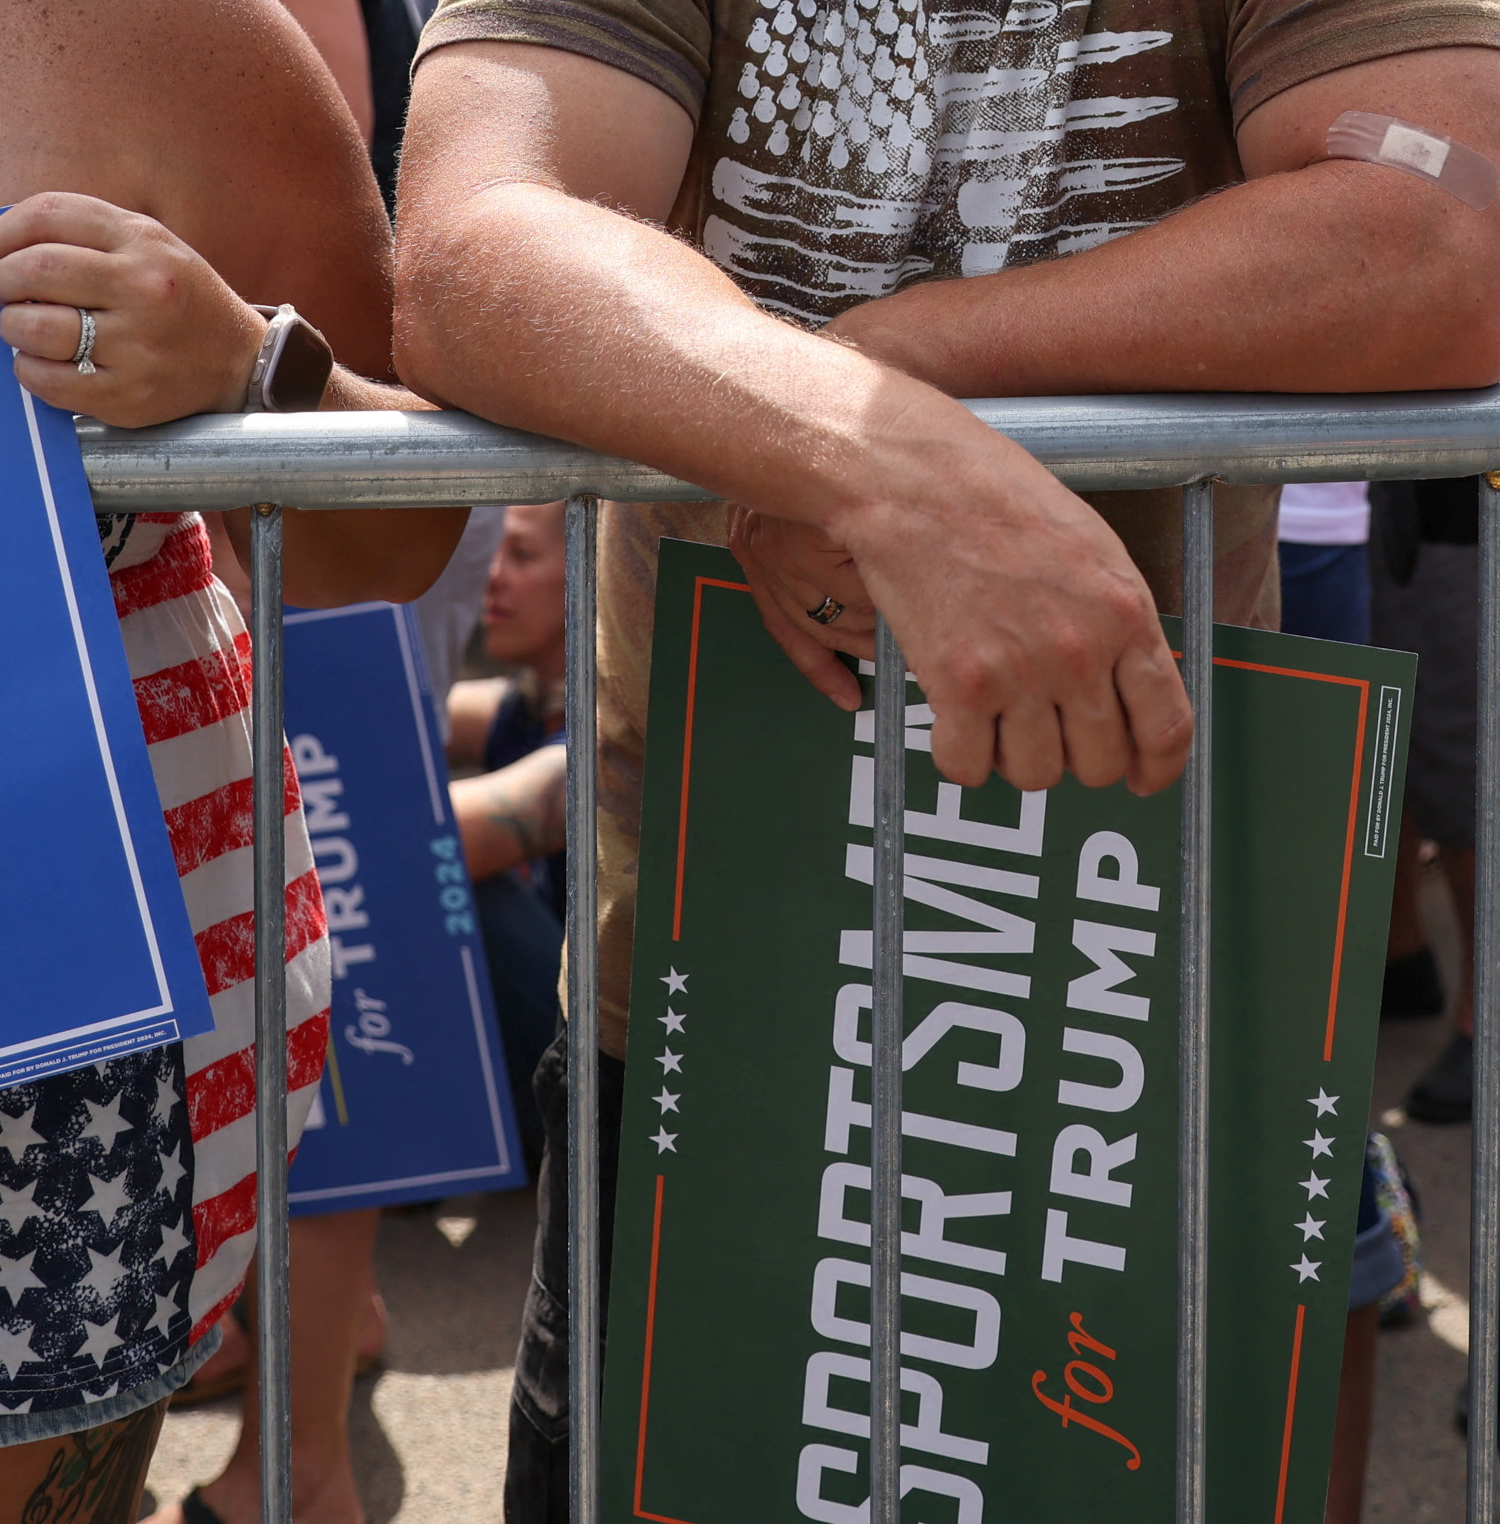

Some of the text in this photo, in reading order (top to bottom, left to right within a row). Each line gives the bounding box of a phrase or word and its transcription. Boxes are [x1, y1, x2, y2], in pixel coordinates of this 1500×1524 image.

[1376, 790, 1384, 814] DONALD
[1376, 813, 1381, 821] BY
[291, 733, 414, 1064] for TRUMP
[431, 837, 473, 936] 2024
[12, 1068, 26, 1076] FOR
[35, 1058, 61, 1069] DONALD
[68, 1050, 89, 1061] TRUMP
[89, 1047, 102, 1055] FOR
[103, 1038, 136, 1052] PRESIDENT
[1033, 831, 1161, 1470] for TRUMP
